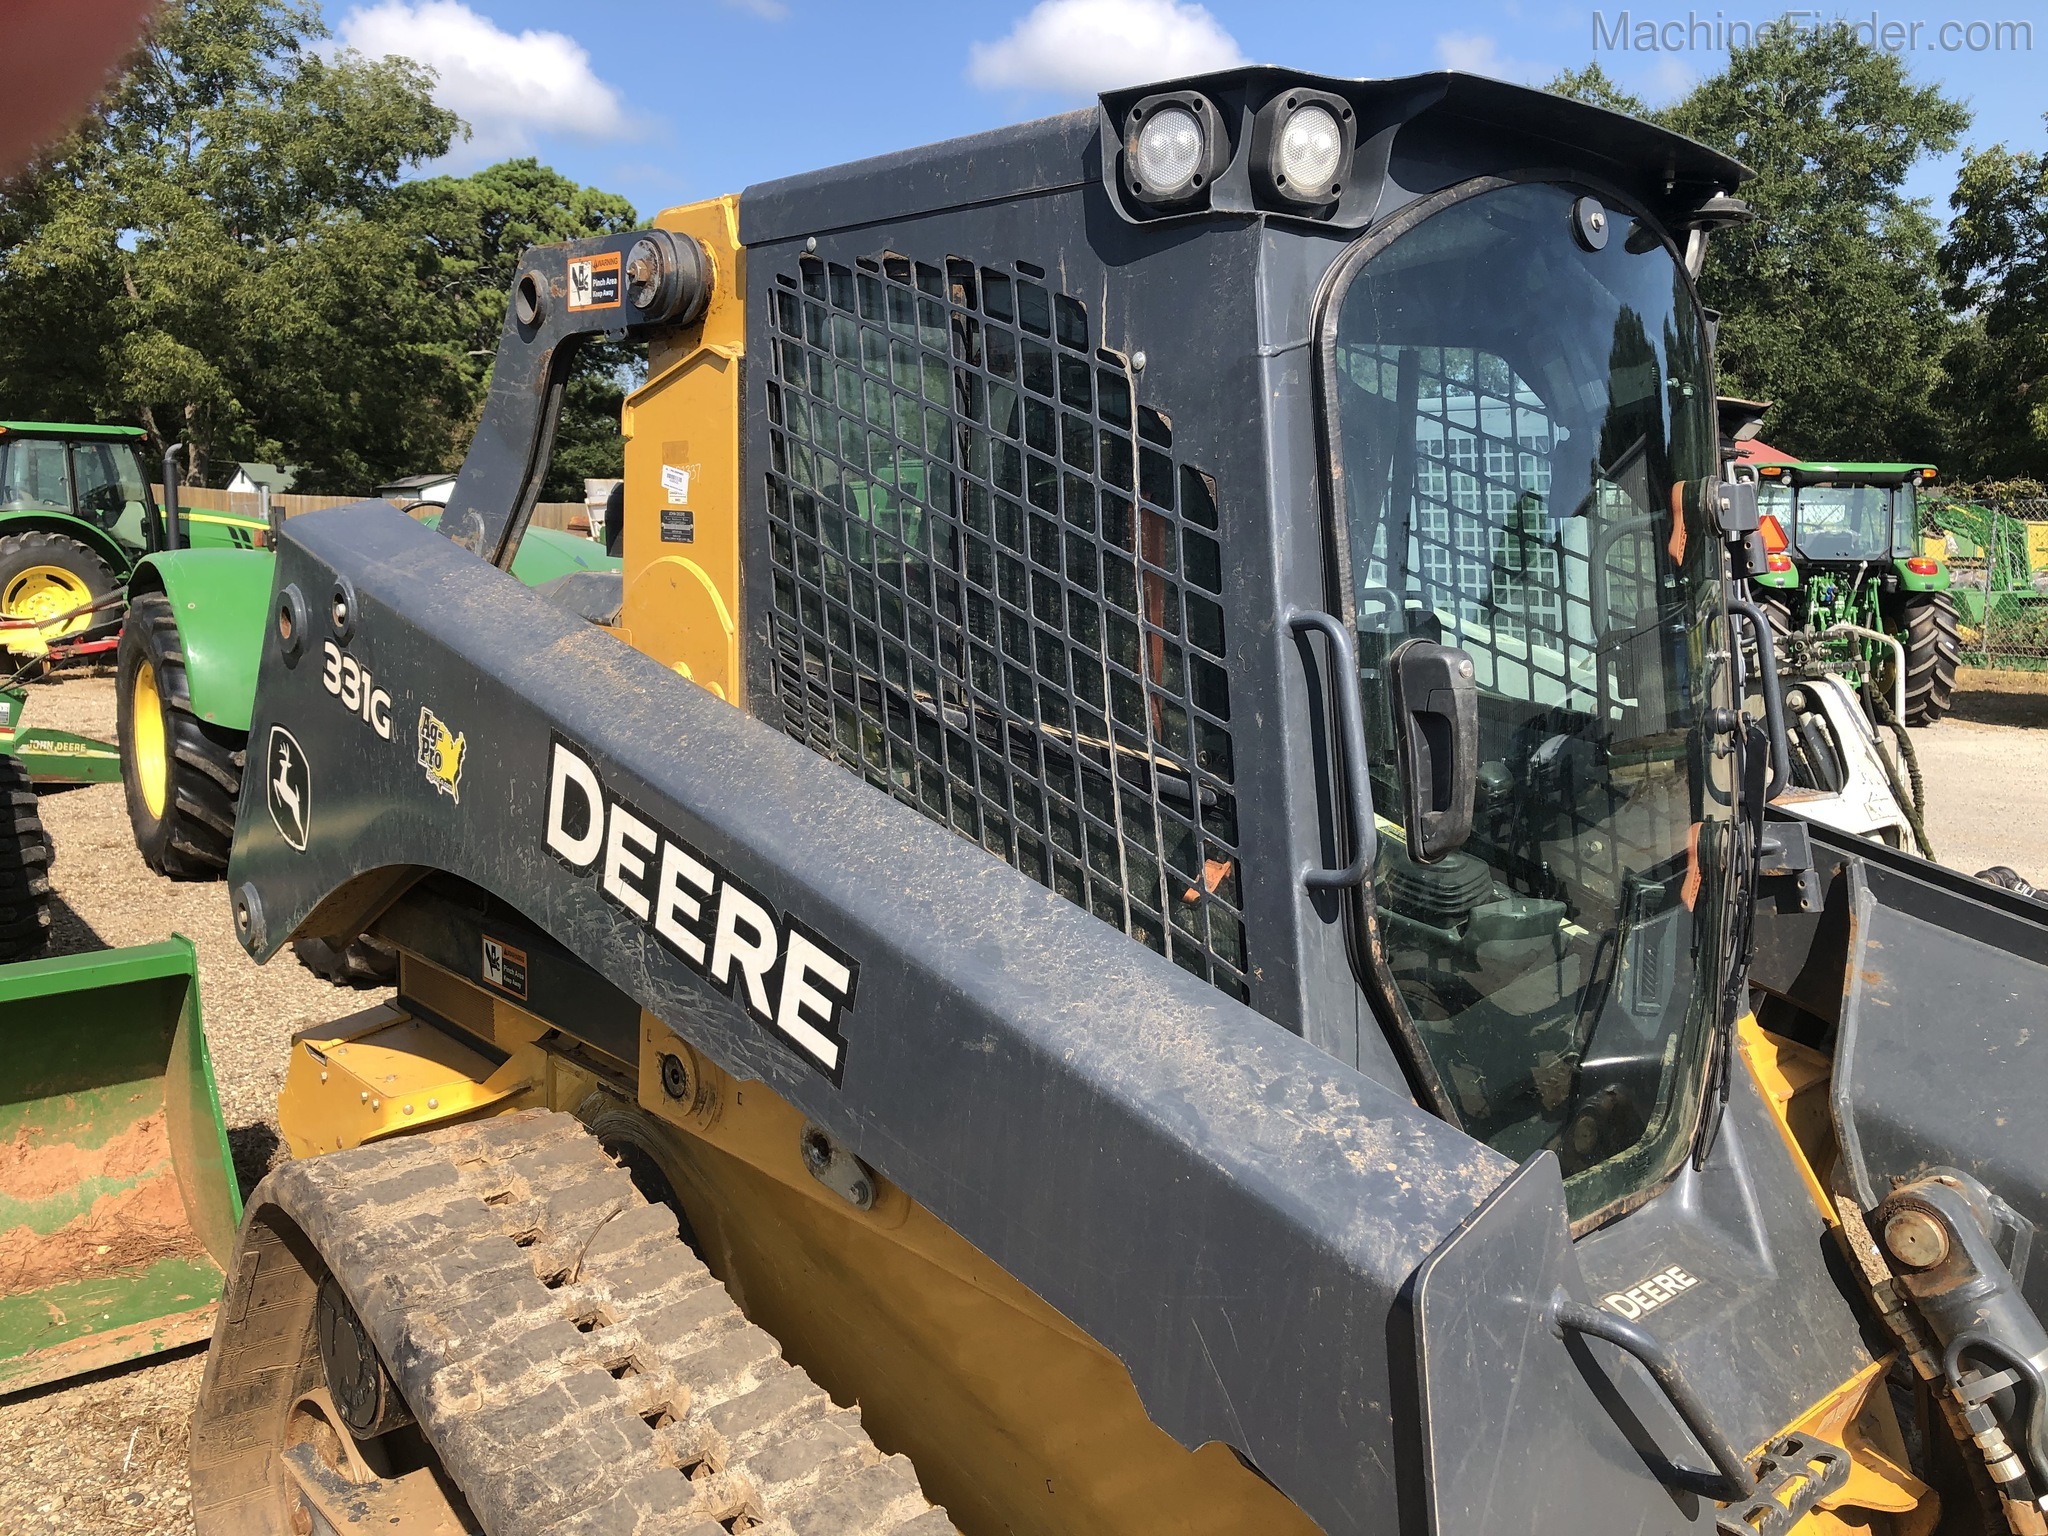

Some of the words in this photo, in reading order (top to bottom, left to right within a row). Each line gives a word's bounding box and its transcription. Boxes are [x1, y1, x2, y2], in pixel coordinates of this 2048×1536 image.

[597, 257, 618, 267] WARNING
[592, 277, 605, 287] Pinch
[605, 277, 618, 286] Area
[592, 290, 603, 299] Keep
[602, 289, 614, 298] Away
[323, 641, 392, 740] 331G
[421, 712, 443, 747] Ag-
[28, 740, 54, 752] JOHN
[55, 742, 87, 752] DEERE
[420, 738, 442, 769] Pro
[547, 742, 851, 1071] DEERE
[1603, 1265, 1699, 1320] DEERE
